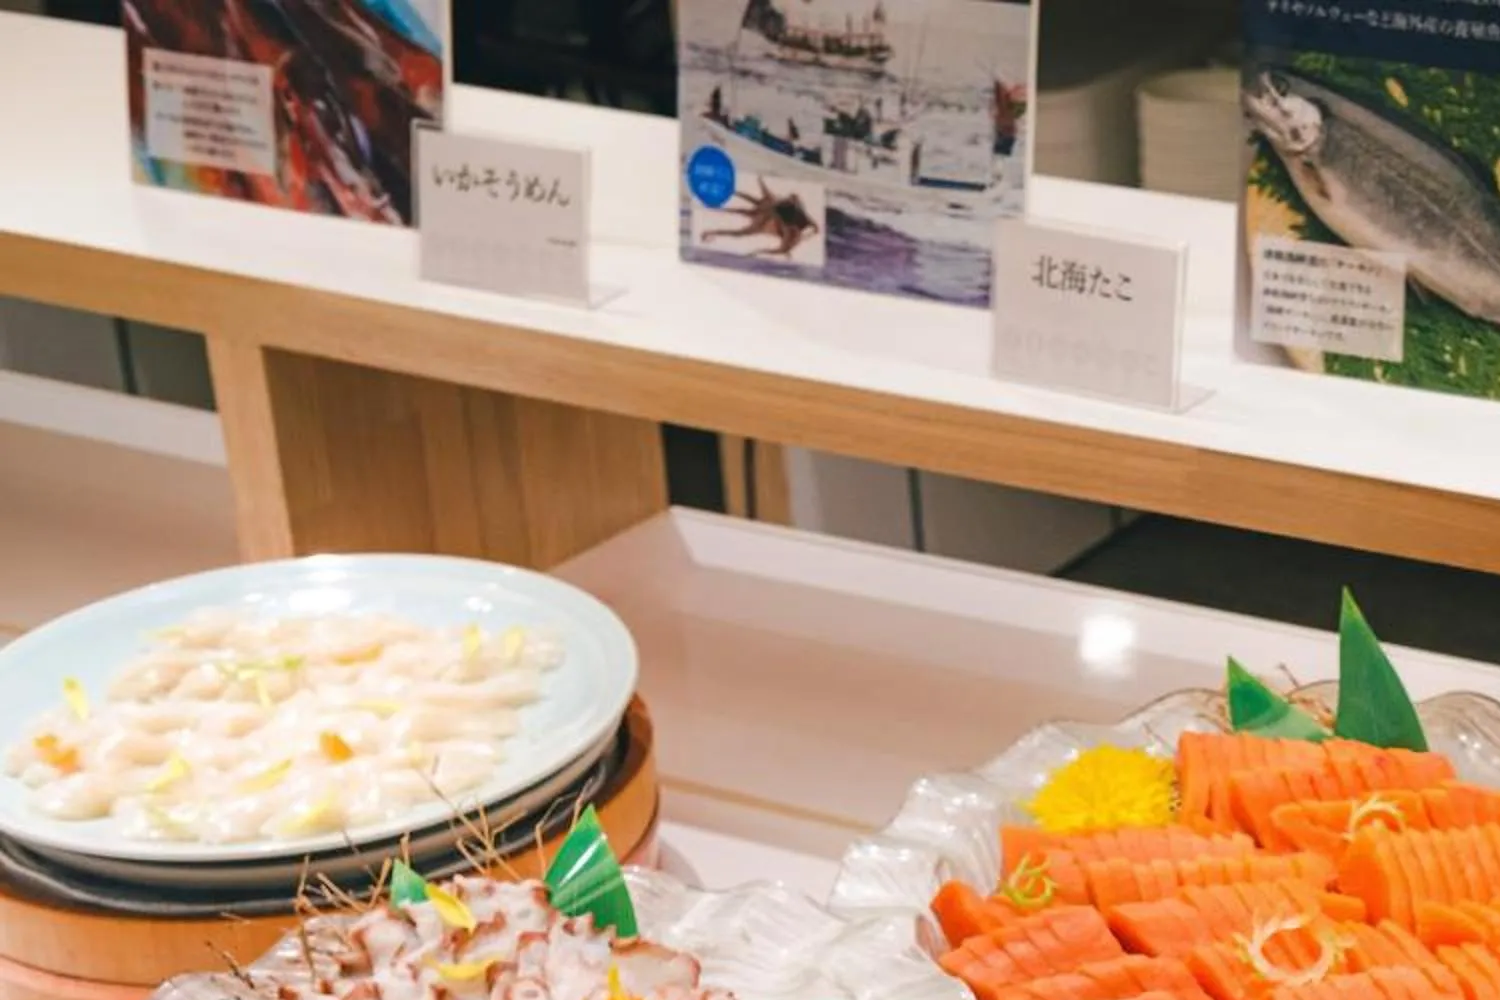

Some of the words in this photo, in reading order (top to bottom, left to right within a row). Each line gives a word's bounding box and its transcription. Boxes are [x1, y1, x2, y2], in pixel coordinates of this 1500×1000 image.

[431, 163, 570, 208] いかそうめん
[1031, 254, 1133, 301] 北海たこ
